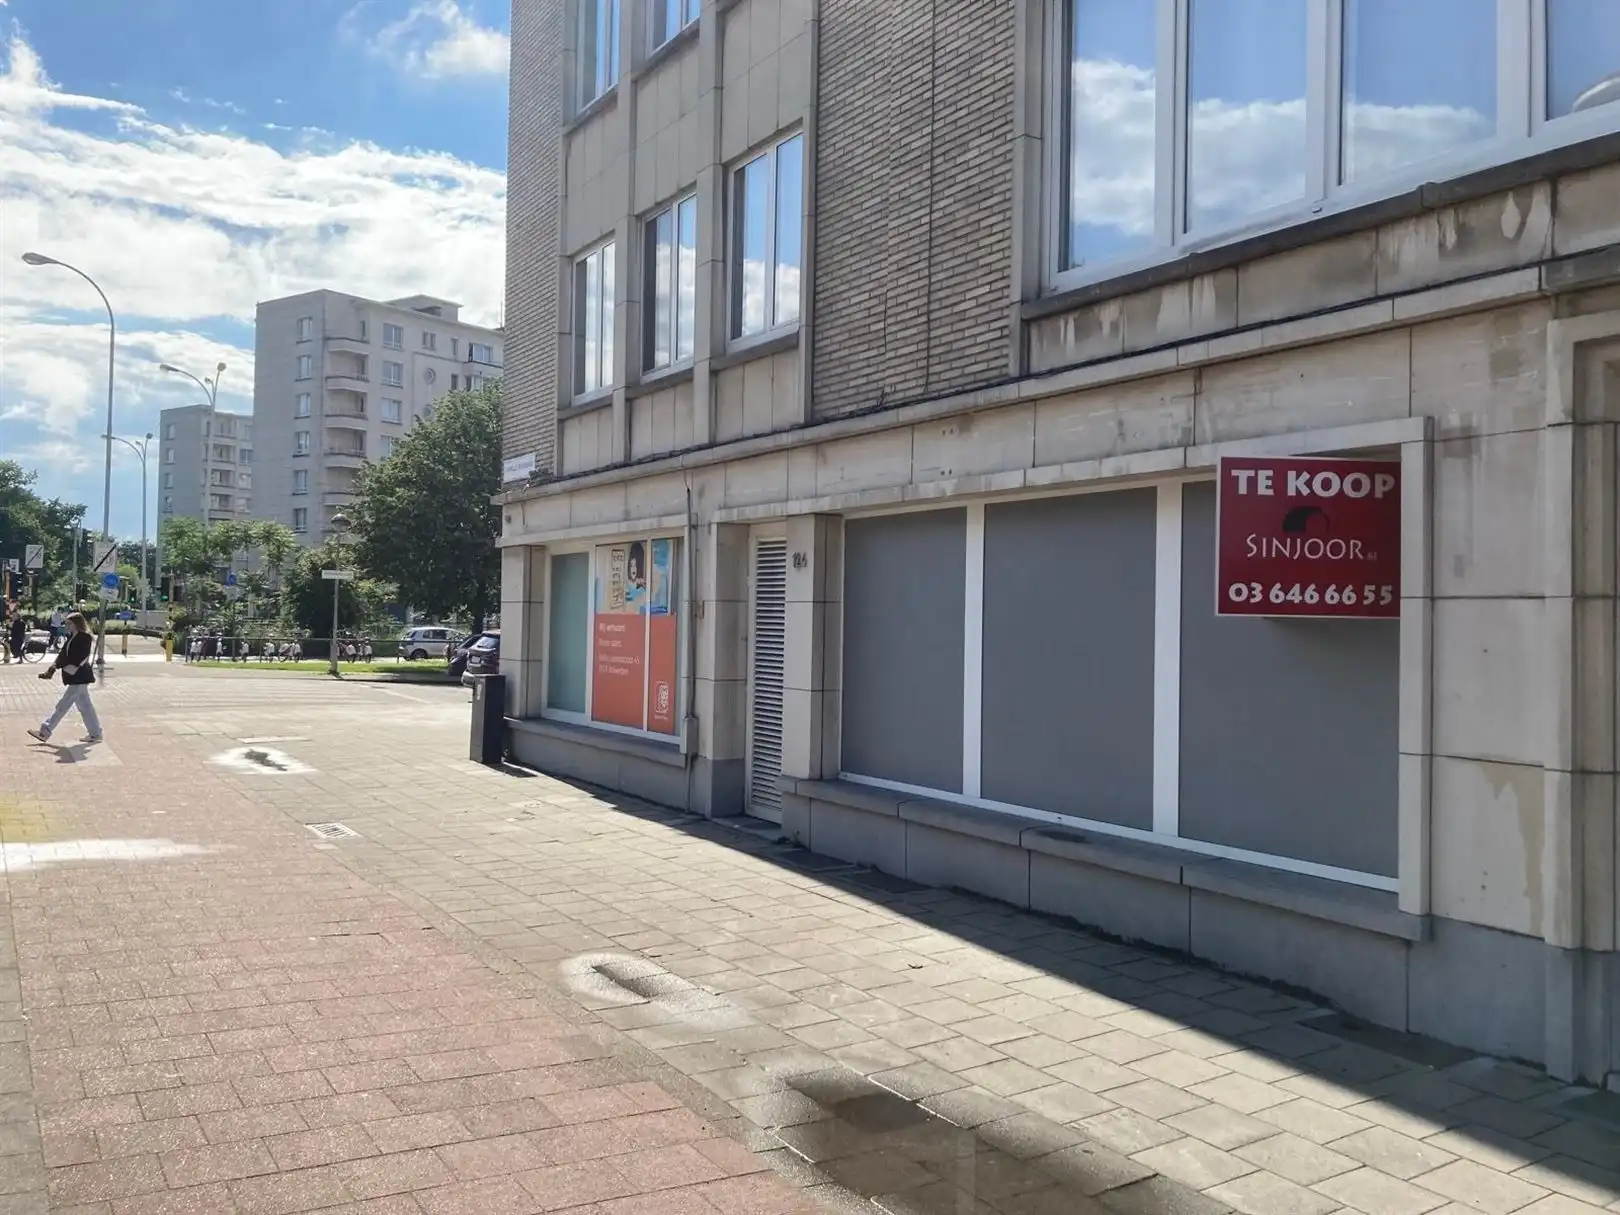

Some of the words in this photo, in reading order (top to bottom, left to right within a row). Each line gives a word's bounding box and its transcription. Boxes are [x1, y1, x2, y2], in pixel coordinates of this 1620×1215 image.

[1231, 469, 1274, 496] TE
[1287, 470, 1395, 498] KOOP
[1246, 533, 1364, 560] SINJOOR
[1228, 582, 1263, 603] 03
[1269, 582, 1320, 604] 646
[1324, 583, 1357, 605] 66
[1362, 584, 1393, 606] 55
